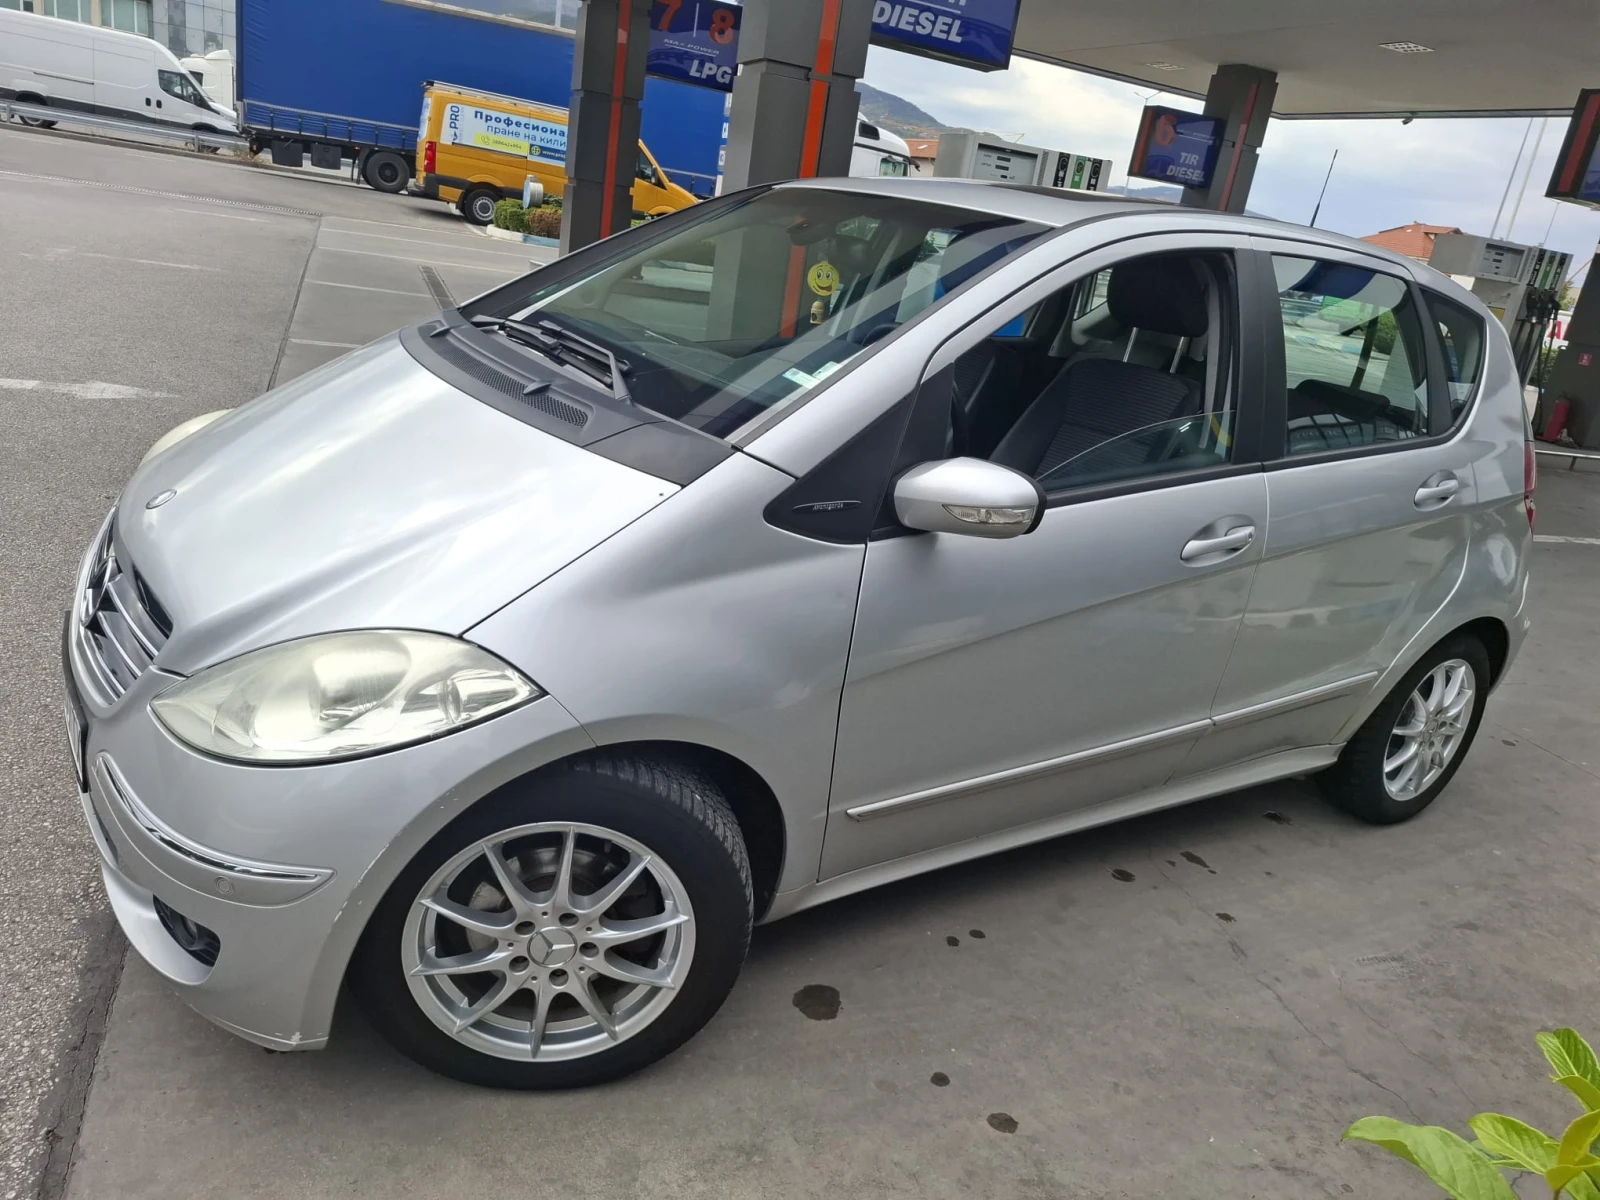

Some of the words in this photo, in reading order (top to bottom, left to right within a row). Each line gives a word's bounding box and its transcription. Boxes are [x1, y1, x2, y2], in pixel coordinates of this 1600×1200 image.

[655, 0, 683, 32] 7
[709, 9, 735, 45] 8
[872, 0, 963, 43] DIESEL
[687, 43, 720, 55] POWER
[689, 59, 733, 84] LPG
[449, 105, 461, 130] PRO
[474, 110, 567, 138] Професиона
[1155, 113, 1177, 147] 6
[486, 125, 521, 138] пране
[524, 132, 537, 142] на
[1179, 152, 1200, 166] TIR
[1166, 164, 1205, 182] DIESEL
